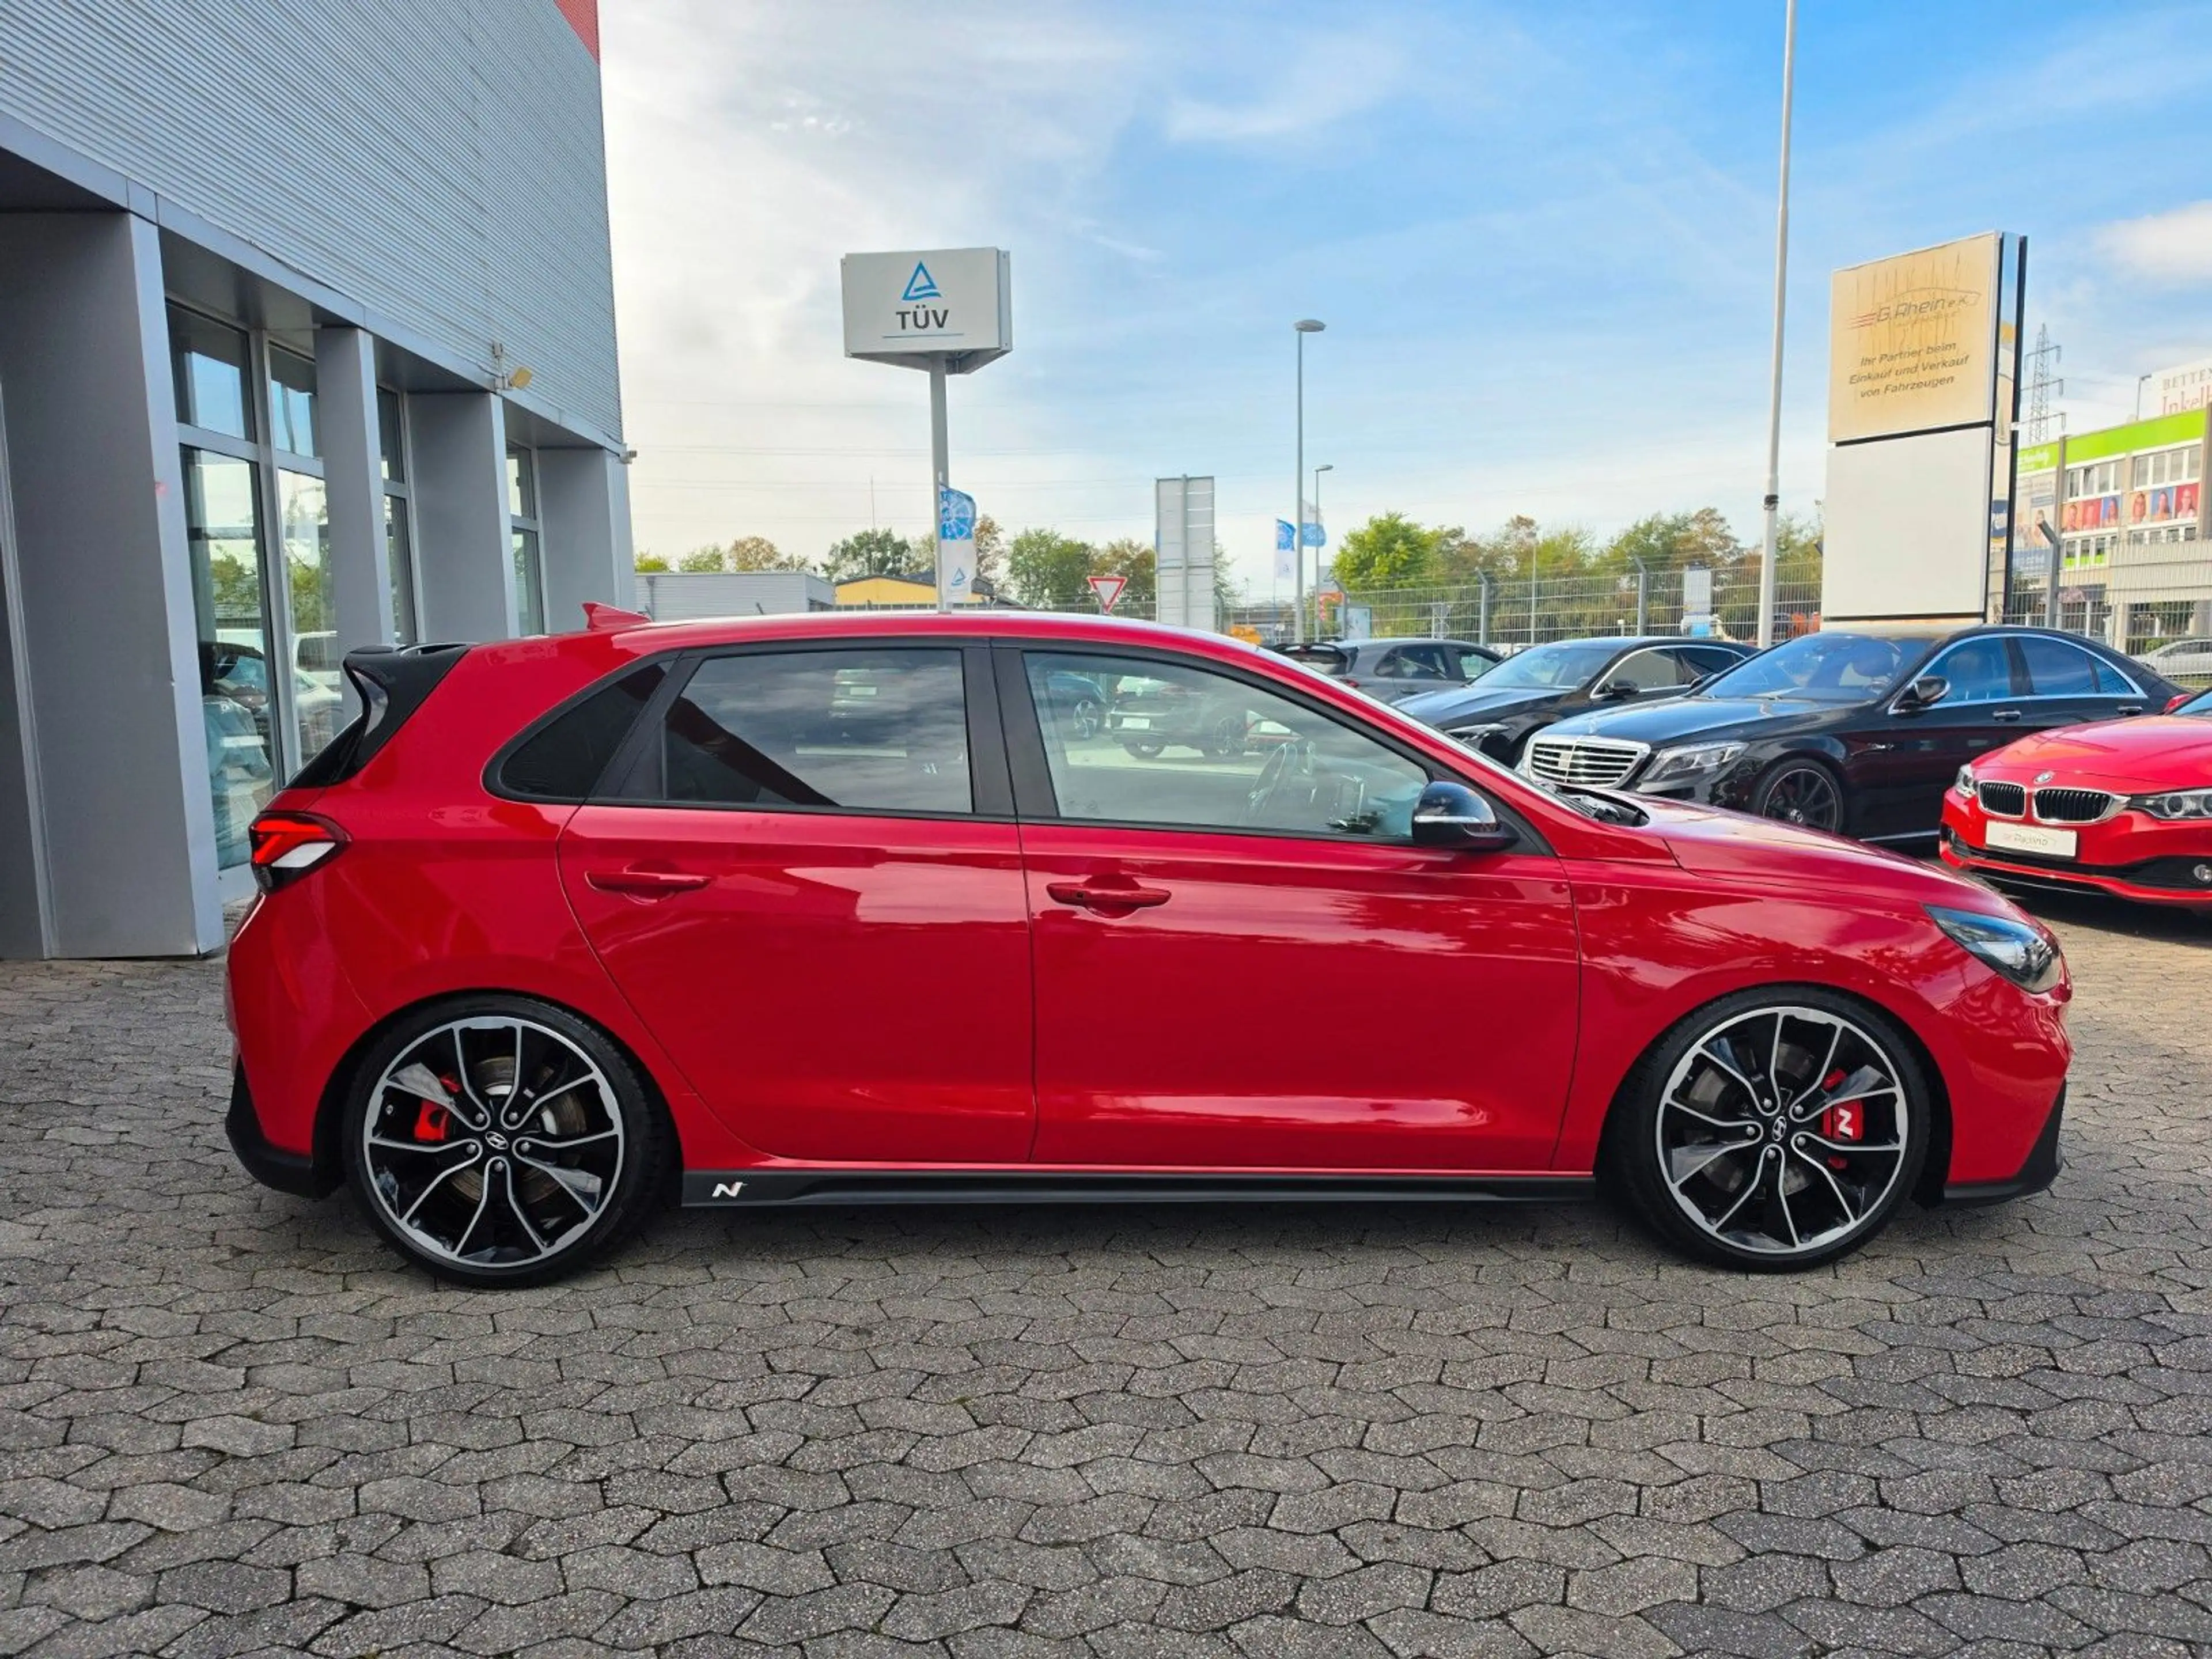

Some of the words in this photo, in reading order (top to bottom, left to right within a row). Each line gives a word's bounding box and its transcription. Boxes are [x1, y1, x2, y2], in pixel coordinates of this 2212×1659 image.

[896, 304, 949, 330] TÜV
[1861, 356, 1877, 367] Ihr
[1879, 350, 1924, 363] Partner
[1926, 343, 1957, 355] beim
[1849, 369, 1892, 385] Einkauf
[1895, 364, 1919, 376] und
[1921, 355, 1970, 372] Verkauf
[1861, 388, 1880, 398] von
[1884, 376, 1955, 395] Fahrzeugen
[712, 1181, 748, 1197] N
